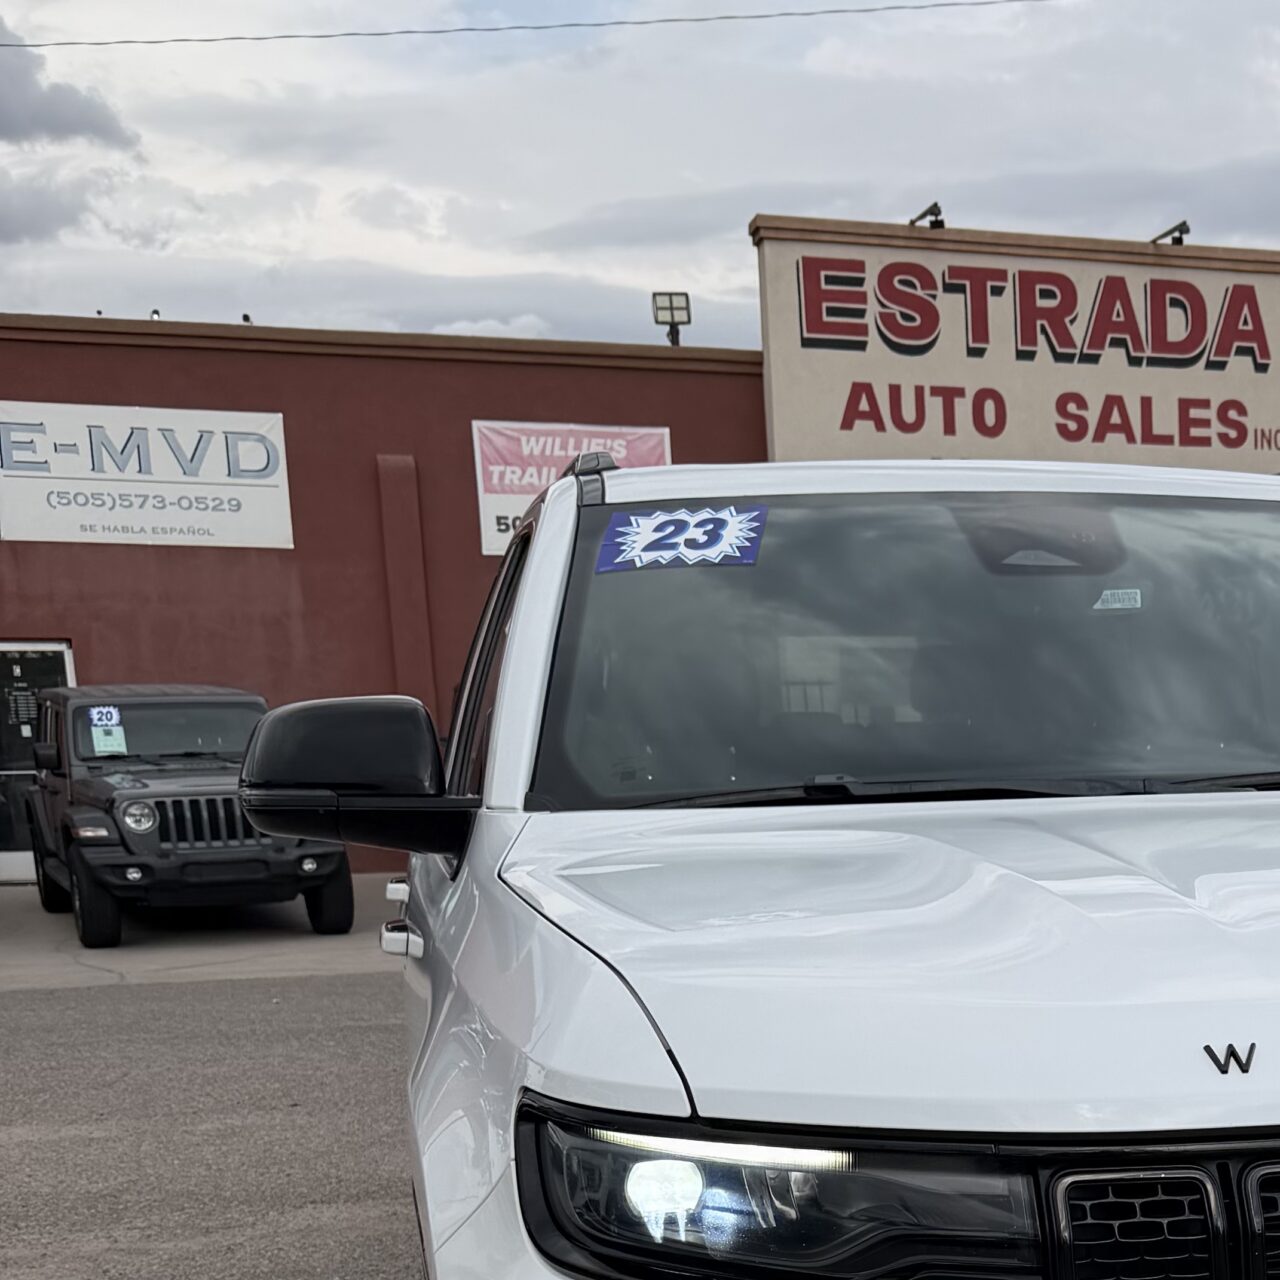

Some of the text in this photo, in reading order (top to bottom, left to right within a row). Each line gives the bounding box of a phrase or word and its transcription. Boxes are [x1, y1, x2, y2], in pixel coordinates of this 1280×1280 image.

[797, 255, 1272, 373] ESTRADA
[839, 380, 1007, 438] AUTO
[1054, 392, 1248, 449] SALES
[0, 421, 280, 479] E-MVD
[520, 435, 627, 459] WILLIE'S
[489, 465, 558, 485] TRAIL
[46, 490, 242, 512] (505)573-0529
[80, 523, 215, 537] SE HABLA ESPAÑOL
[496, 515, 522, 532] 50
[641, 517, 728, 552] 23
[96, 711, 113, 722] 20
